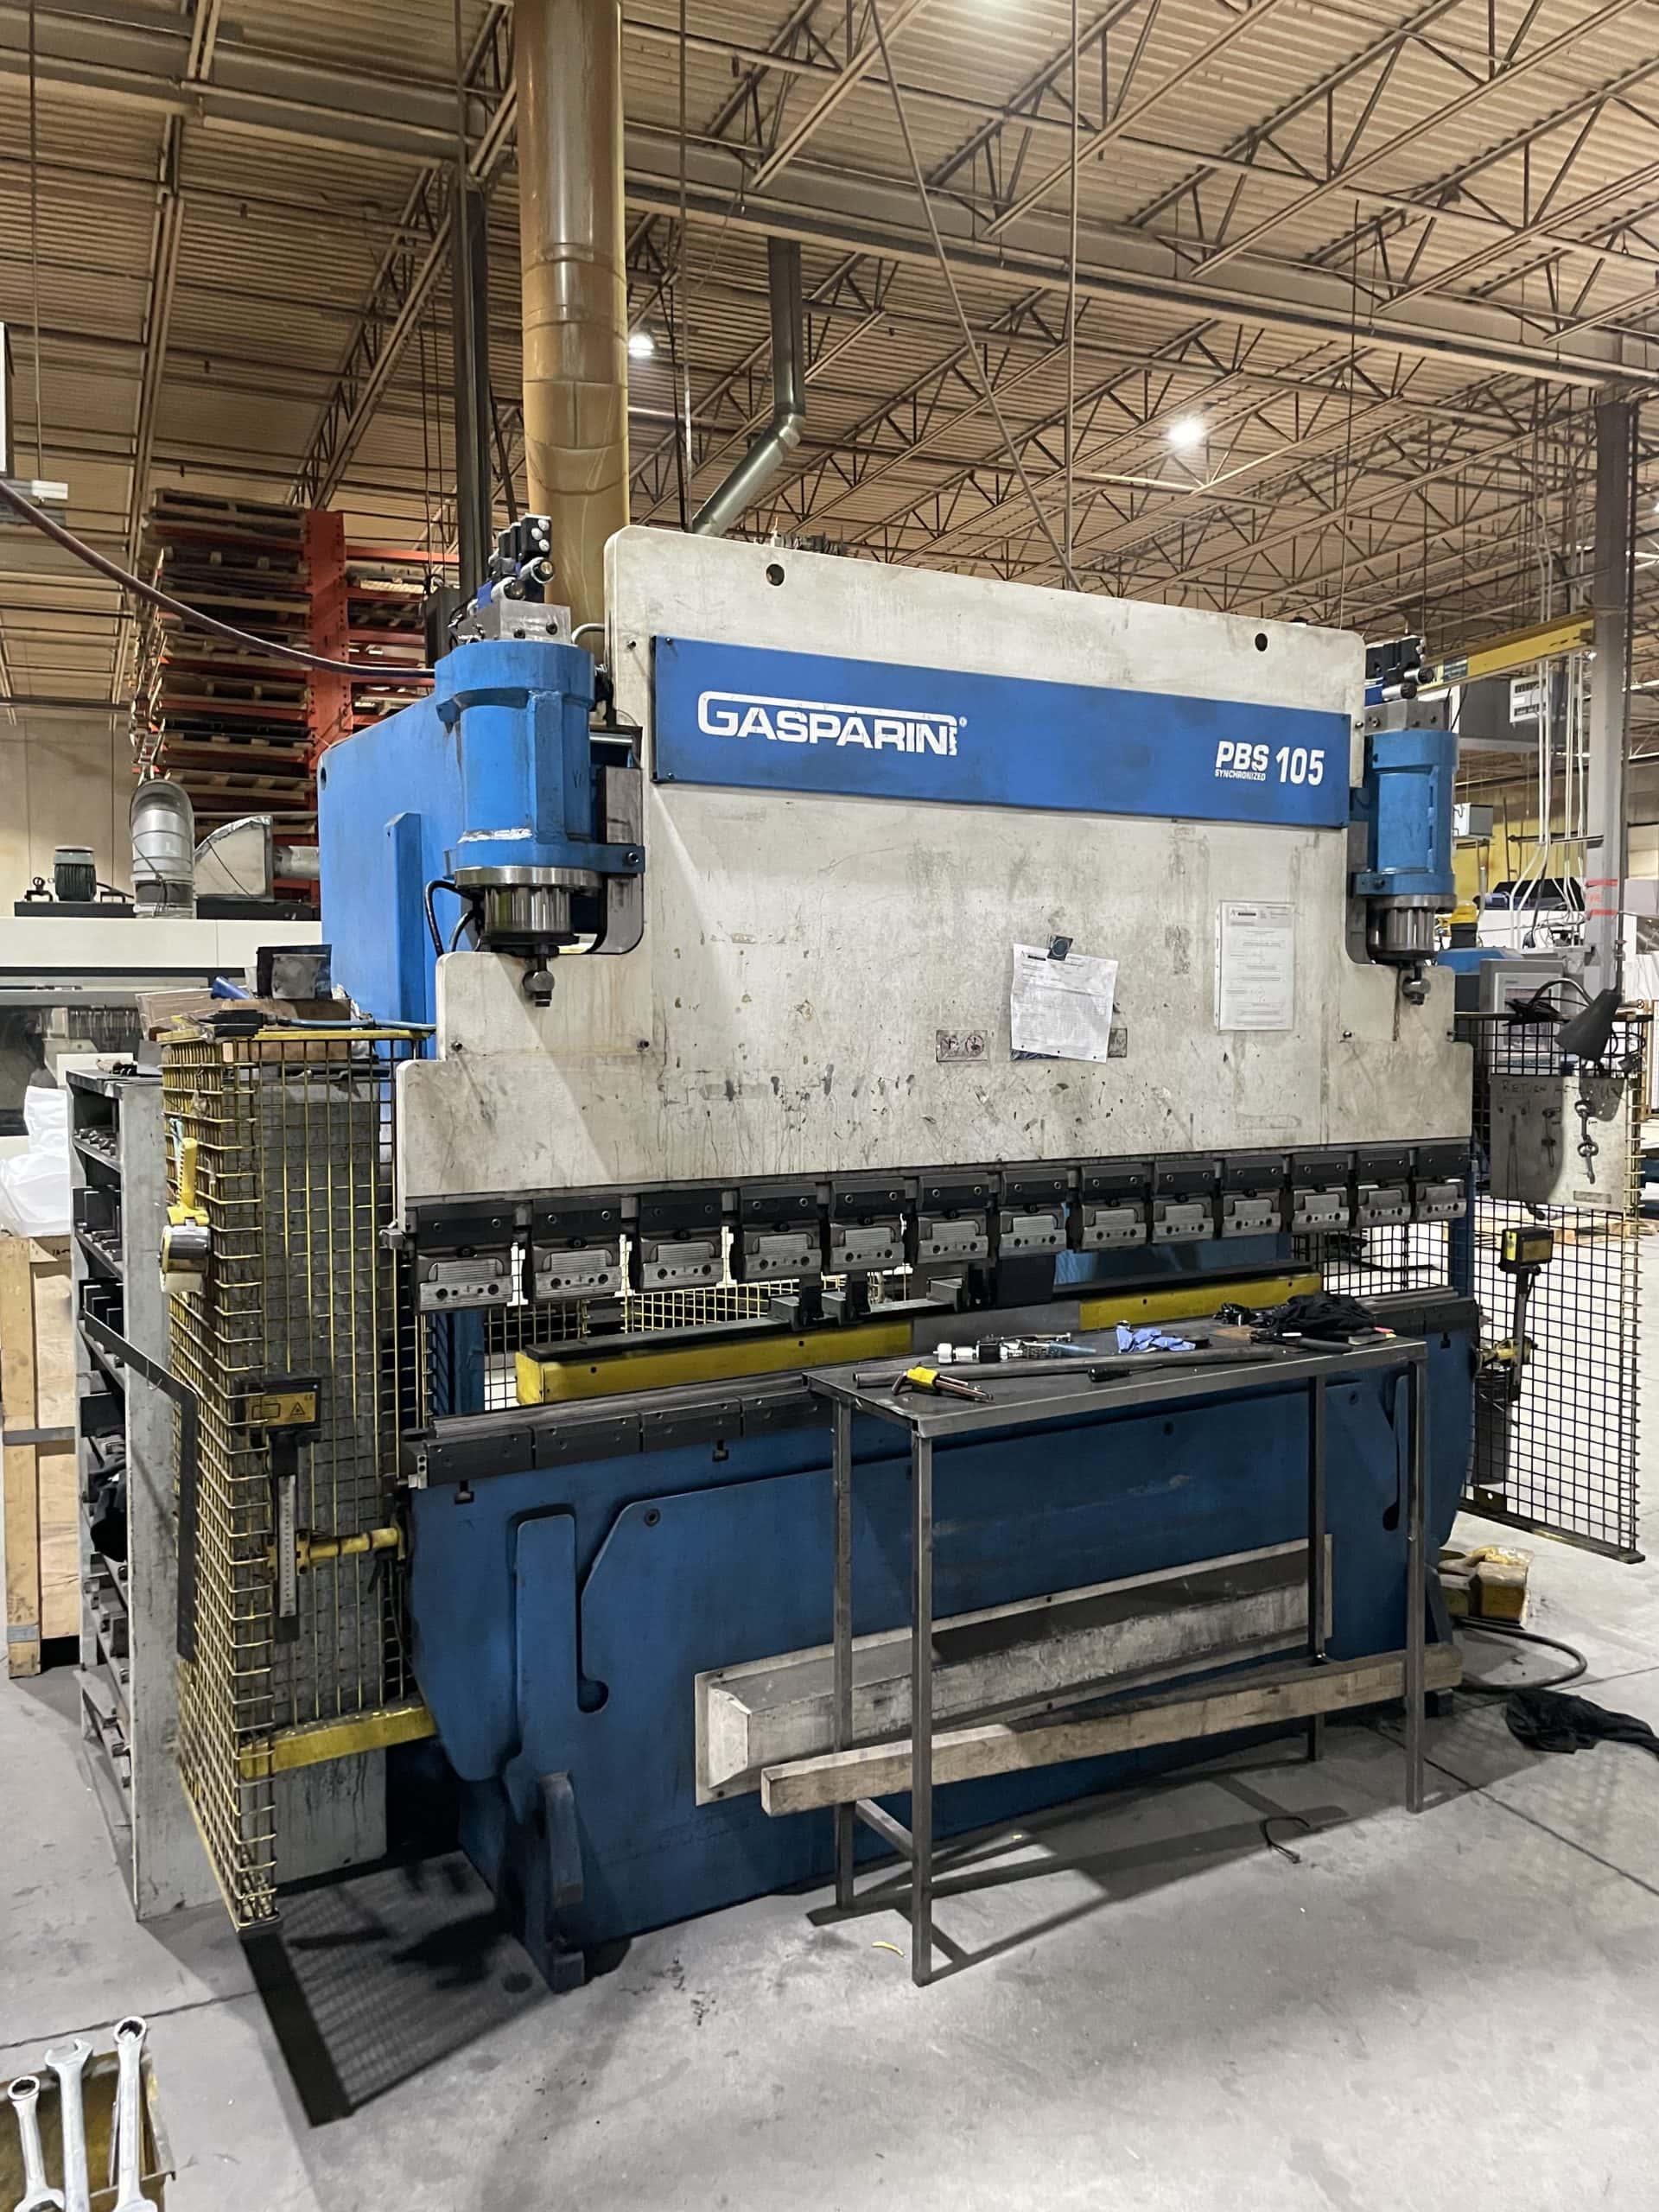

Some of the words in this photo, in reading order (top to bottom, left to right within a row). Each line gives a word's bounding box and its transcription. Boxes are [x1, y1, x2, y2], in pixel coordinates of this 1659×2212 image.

[698, 690, 957, 756] GASPARINI
[1215, 741, 1269, 772] PBS
[1275, 747, 1325, 785] 105
[1215, 768, 1266, 781] SYNCHRONIZED
